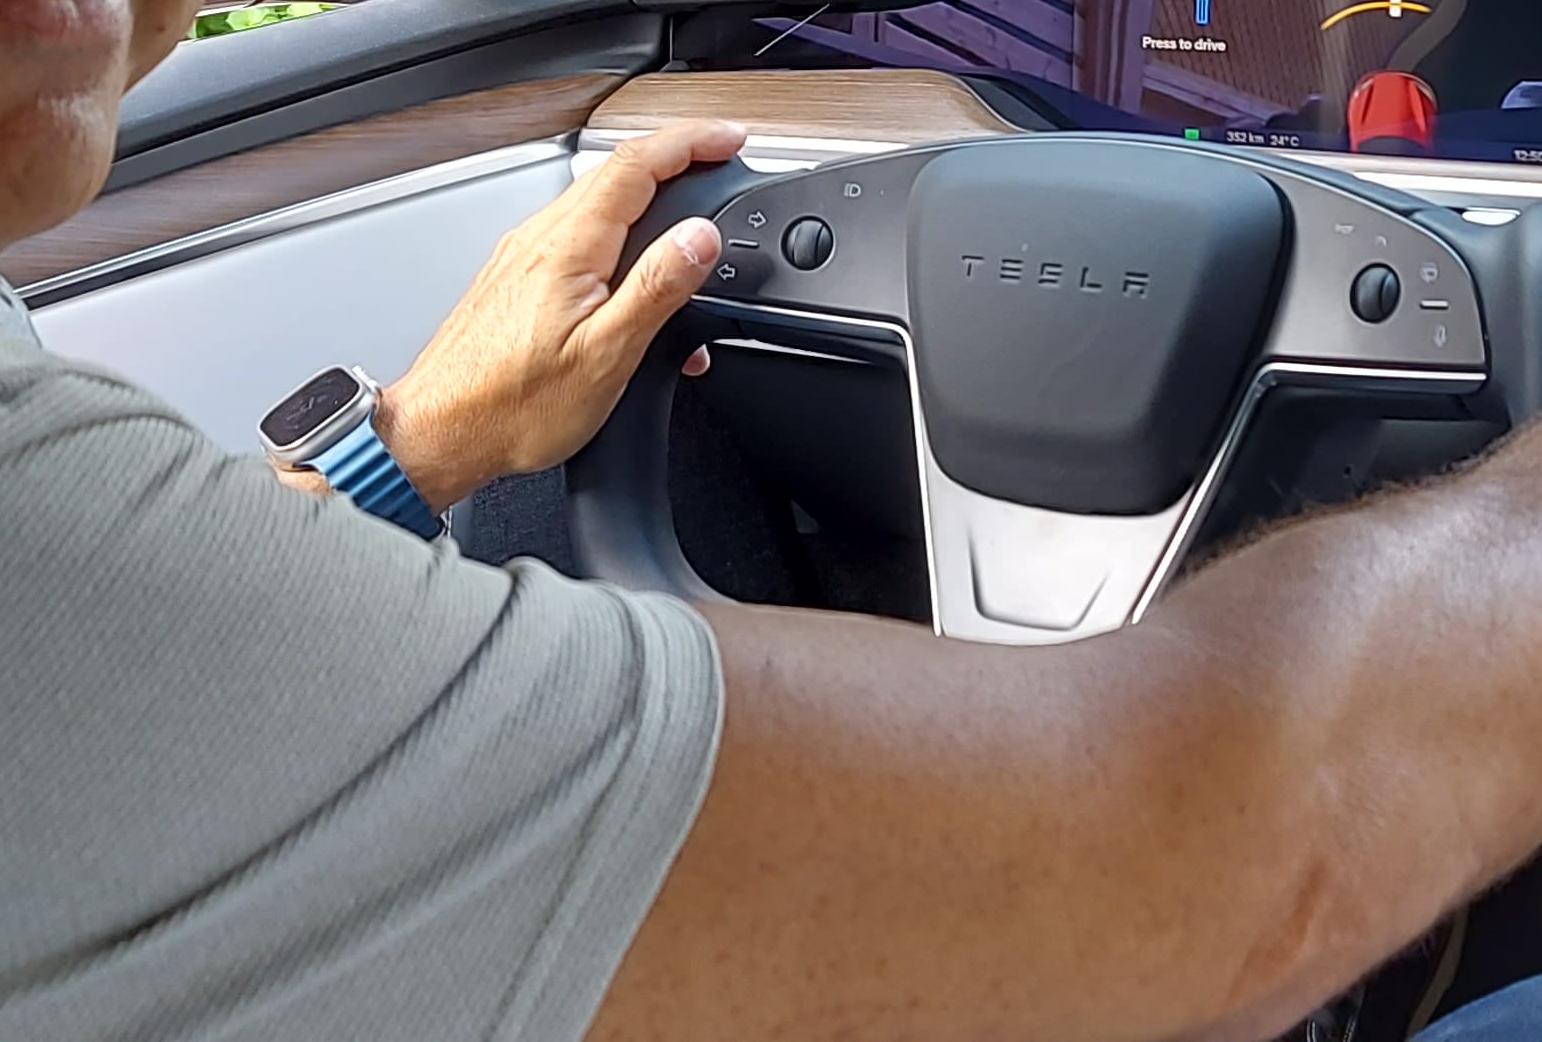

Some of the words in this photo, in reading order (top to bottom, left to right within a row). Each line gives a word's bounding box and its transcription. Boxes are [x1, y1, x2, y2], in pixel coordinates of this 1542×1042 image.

[1142, 36, 1177, 51] Press
[1179, 38, 1192, 50] to
[1194, 38, 1227, 52] drive
[961, 254, 1150, 298] TESLA
